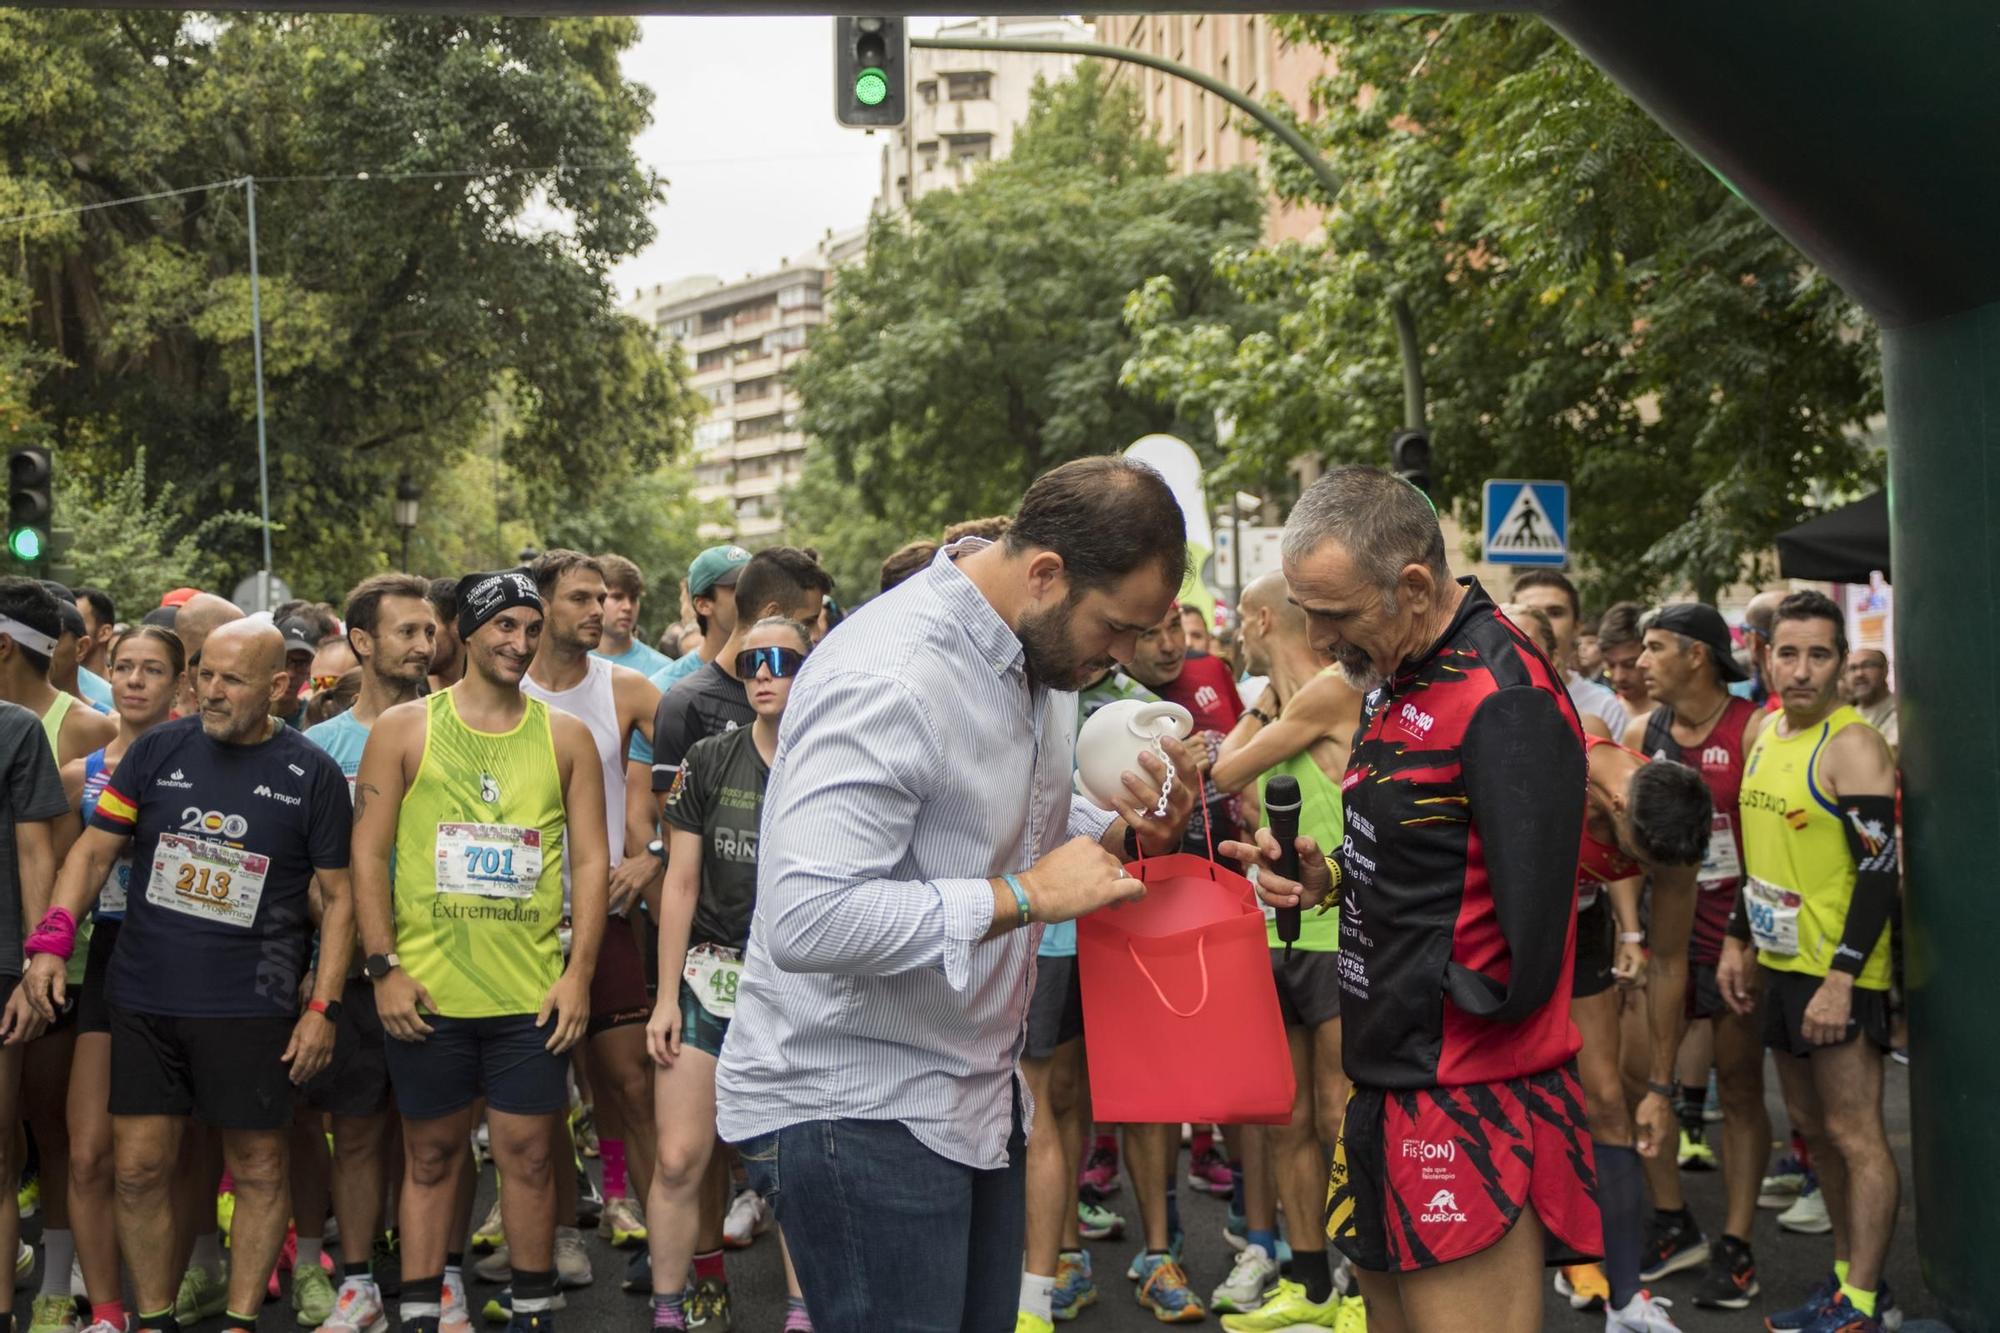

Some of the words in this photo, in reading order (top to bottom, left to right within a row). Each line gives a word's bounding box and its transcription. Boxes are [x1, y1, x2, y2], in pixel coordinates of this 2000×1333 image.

[1401, 703, 1434, 731] GR-100
[156, 777, 193, 790] Santander
[273, 790, 301, 806] mupol
[464, 846, 515, 876] 701
[175, 862, 232, 899] 213
[432, 901, 540, 923] Extremadura
[1420, 1212, 1468, 1223] austral
